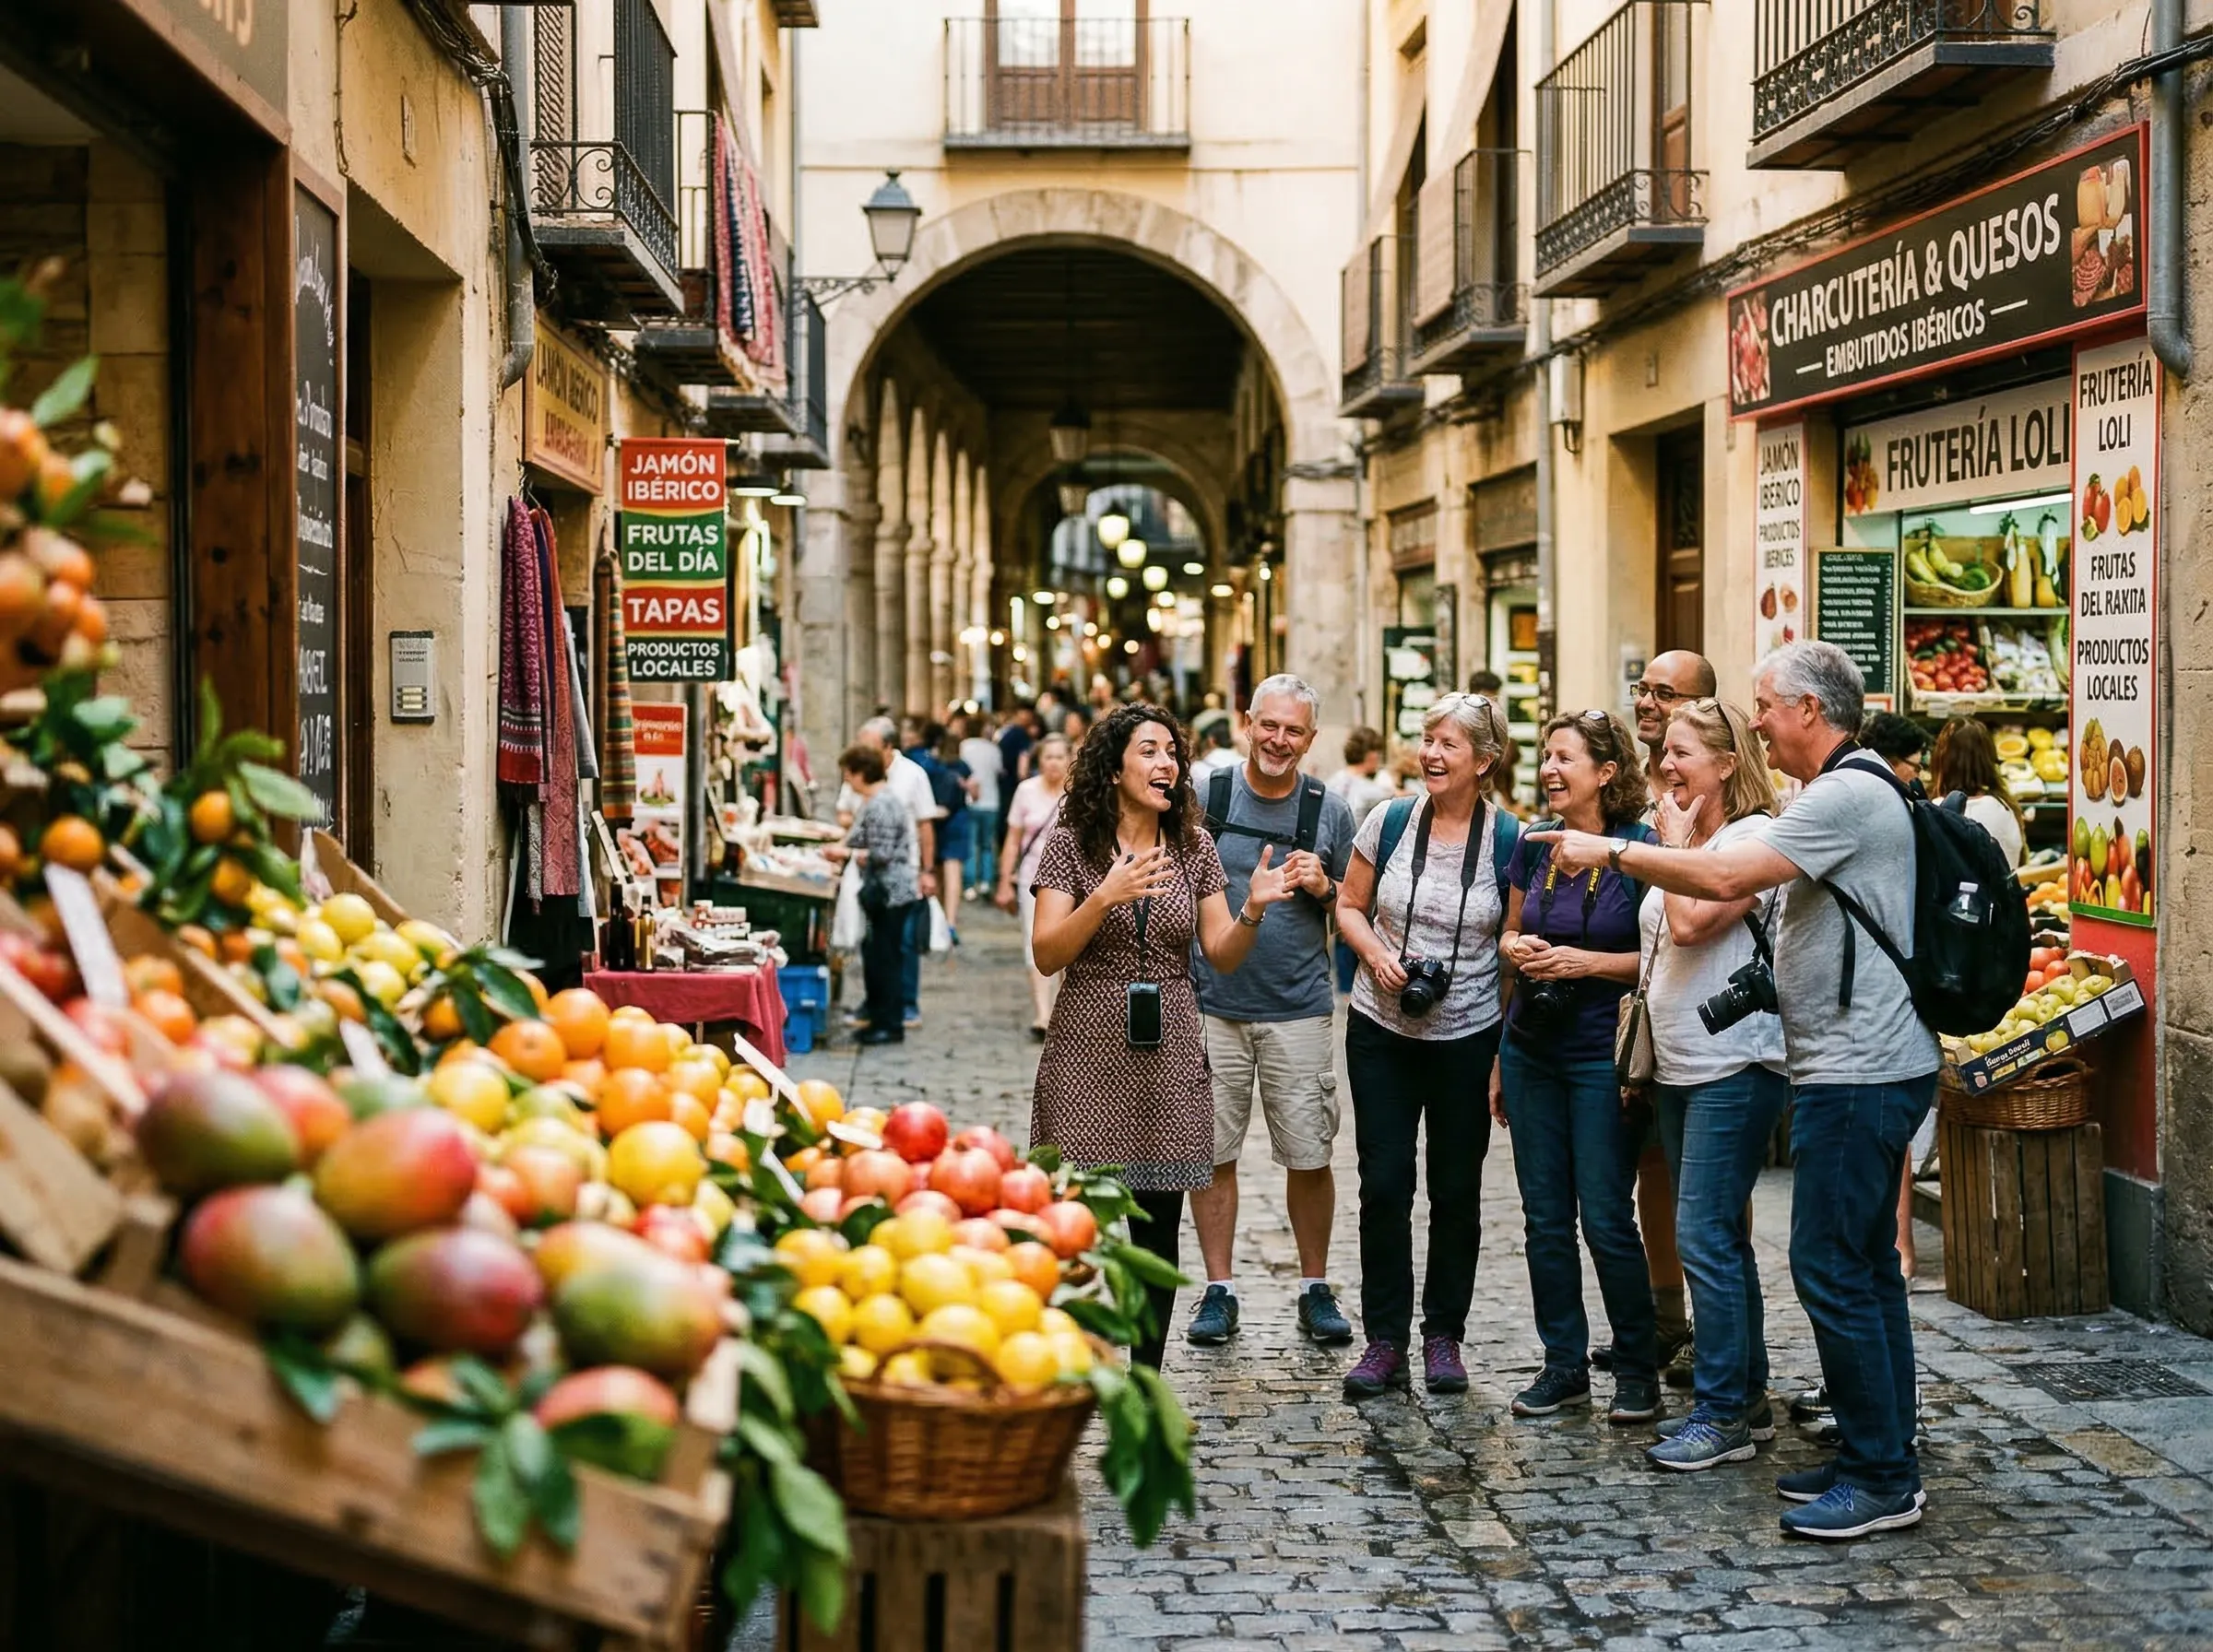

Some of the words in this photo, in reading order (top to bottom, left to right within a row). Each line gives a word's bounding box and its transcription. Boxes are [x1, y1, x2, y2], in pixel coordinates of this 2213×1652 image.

[1770, 240, 1921, 348] CHARCUTERÍA
[1923, 240, 1944, 297] &
[1948, 193, 2062, 291] QUESOS
[1826, 324, 1909, 378] EMBUTIDOS
[1911, 298, 1986, 353] IBÉRICOS
[2079, 355, 2153, 408] FRUTERÍA
[1887, 406, 2003, 491] FRUTERÍA
[2010, 402, 2070, 471] LOLI
[2099, 414, 2130, 452] LOLI
[630, 450, 716, 475] JAMÓN
[1760, 435, 1799, 477] JAMÓN
[627, 476, 720, 501] IBÉRICO
[1759, 477, 1801, 510] IBÉRICO
[627, 525, 719, 545] FRUTAS
[628, 551, 673, 572] DEL
[679, 547, 719, 572] DÍA
[2091, 551, 2136, 581] FRUTAS
[627, 597, 720, 623] TAPAS
[2081, 591, 2102, 617] DEL
[627, 643, 720, 656] PRODUCTOS
[2077, 638, 2149, 666] PRODUCTOS
[632, 660, 716, 677] LOCALES
[2087, 675, 2138, 702] LOCALES
